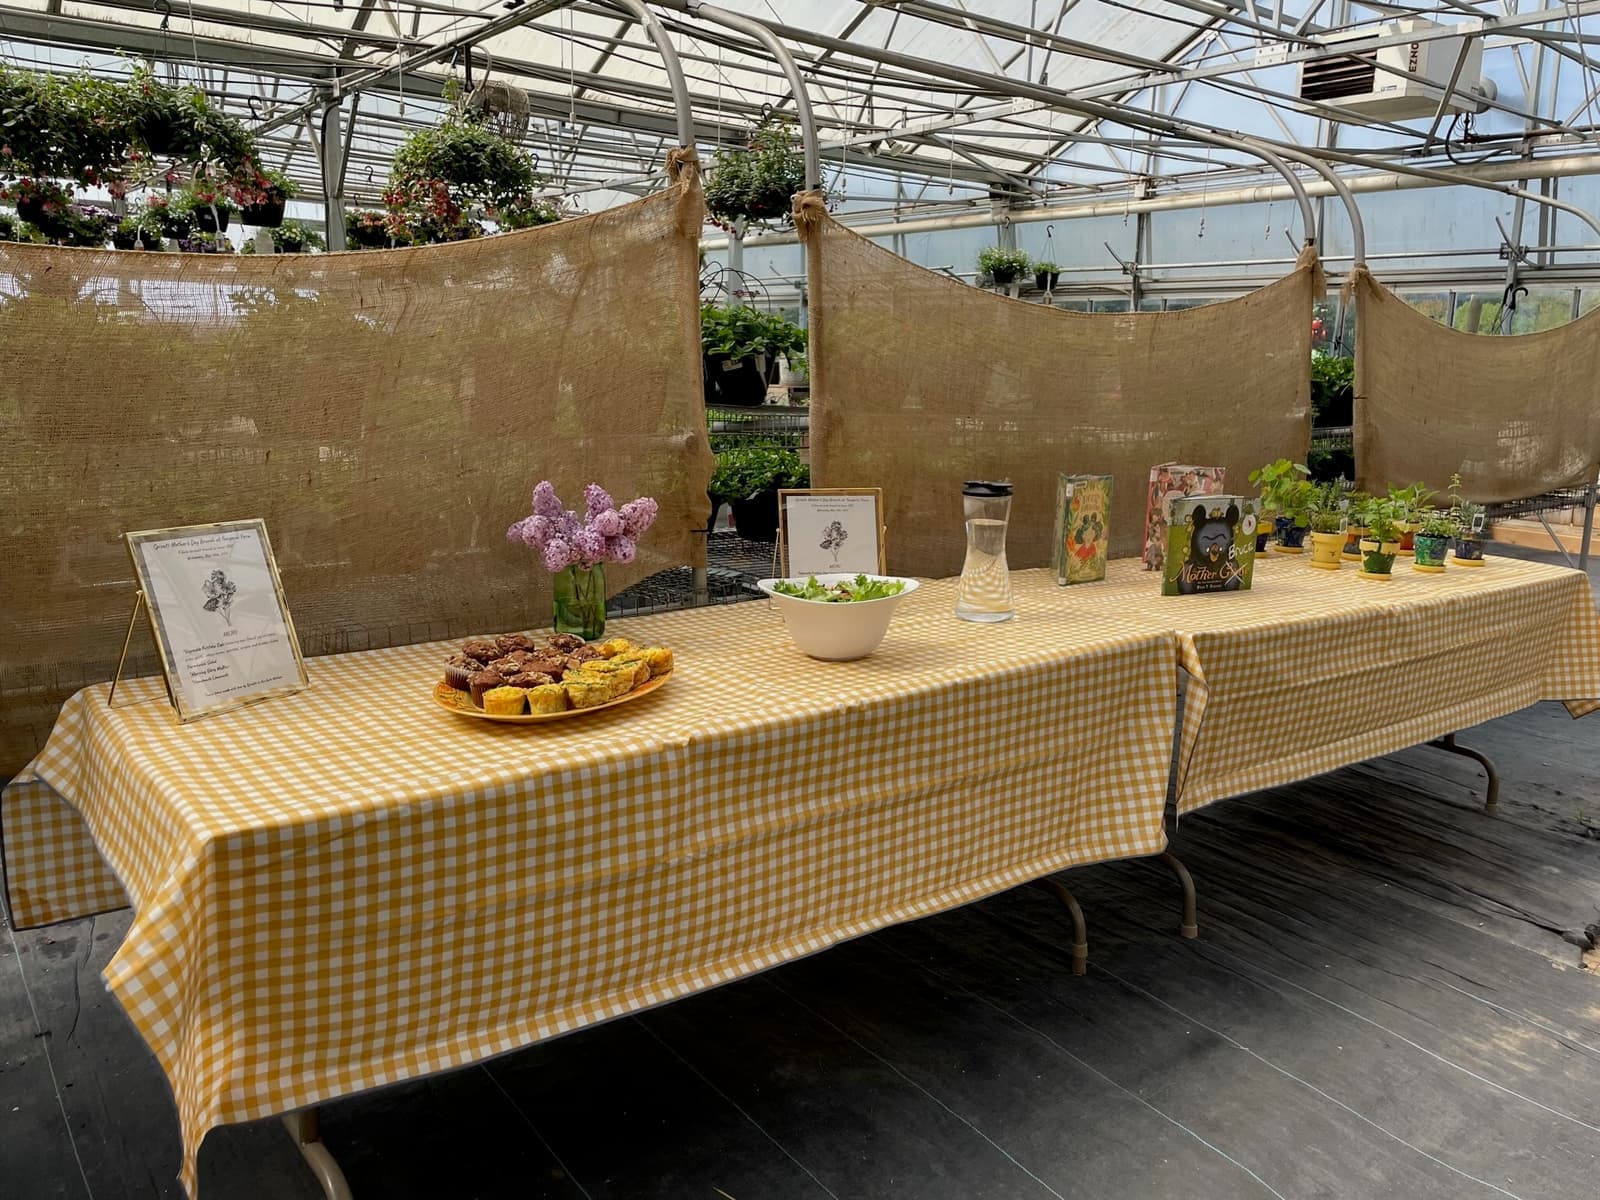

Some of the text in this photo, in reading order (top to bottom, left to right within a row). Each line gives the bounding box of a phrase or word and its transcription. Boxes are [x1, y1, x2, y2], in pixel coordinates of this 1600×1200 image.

[1409, 42, 1419, 72] EZNO
[1229, 542, 1253, 560] Bruce
[1169, 561, 1217, 583] Mother
